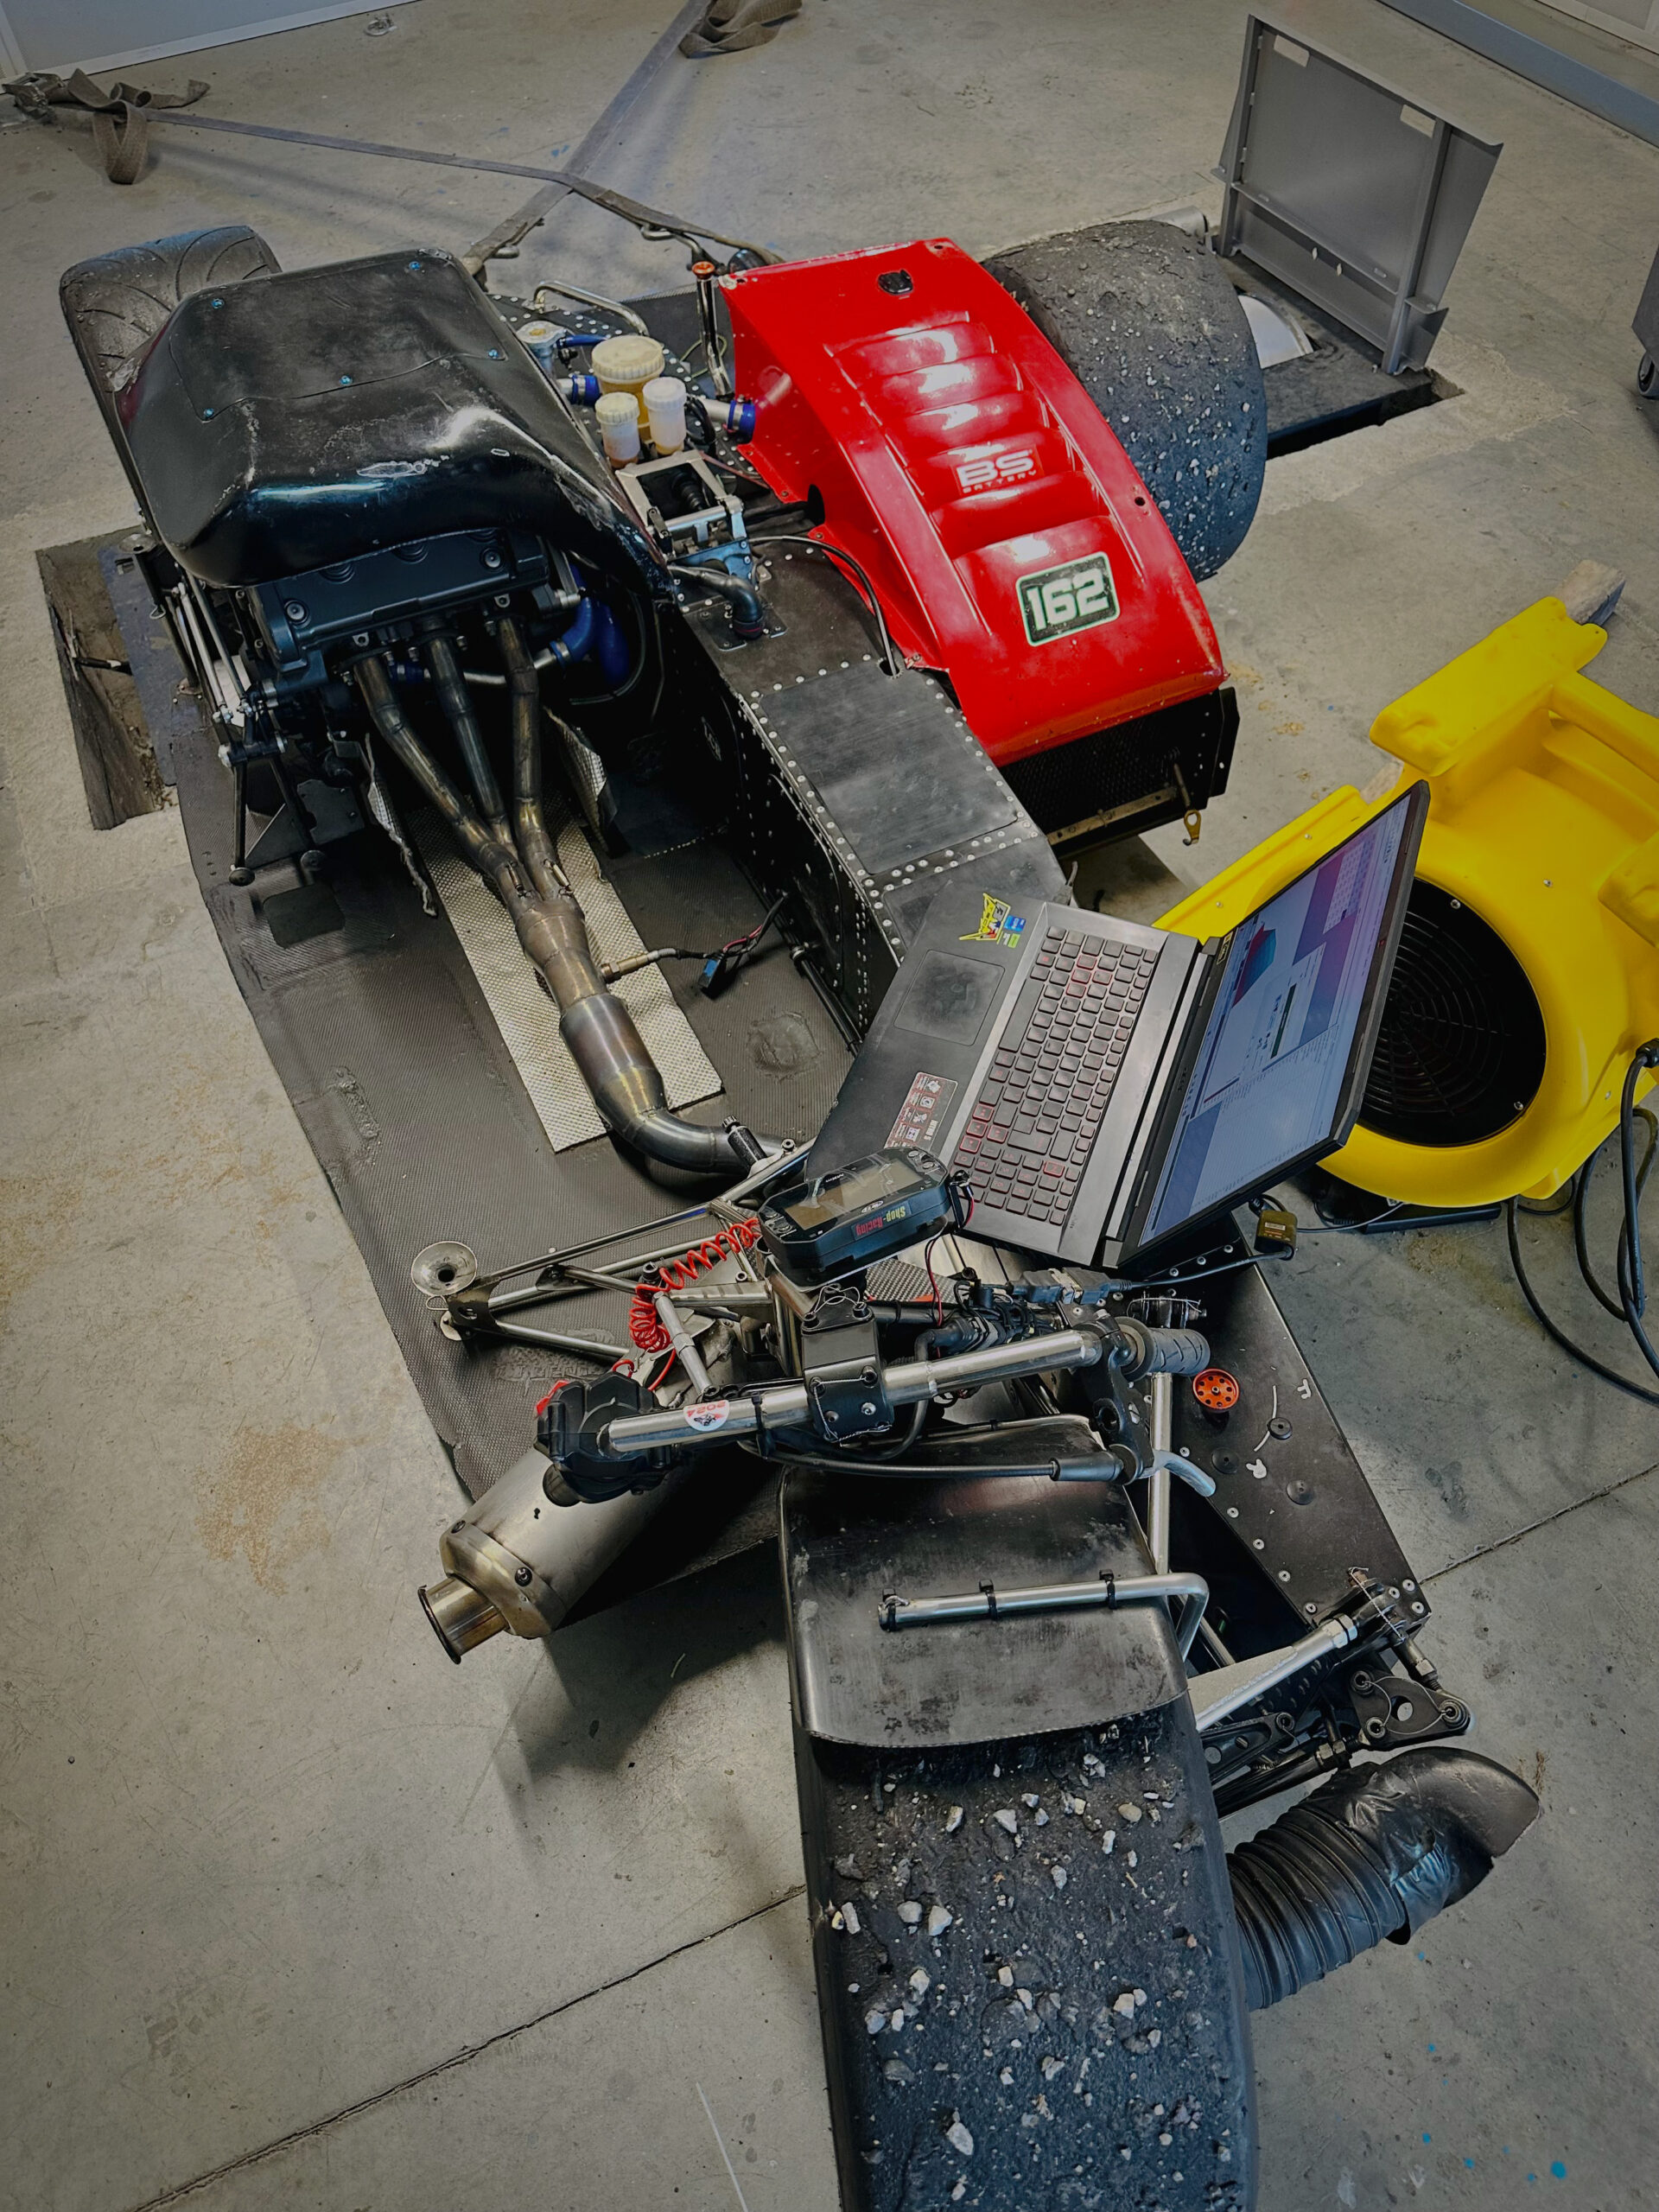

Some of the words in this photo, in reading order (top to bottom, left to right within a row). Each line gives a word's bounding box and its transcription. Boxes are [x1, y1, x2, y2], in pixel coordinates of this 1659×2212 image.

[956, 448, 1034, 488] BS
[962, 469, 1037, 494] BATTERY
[1027, 569, 1109, 631] 162
